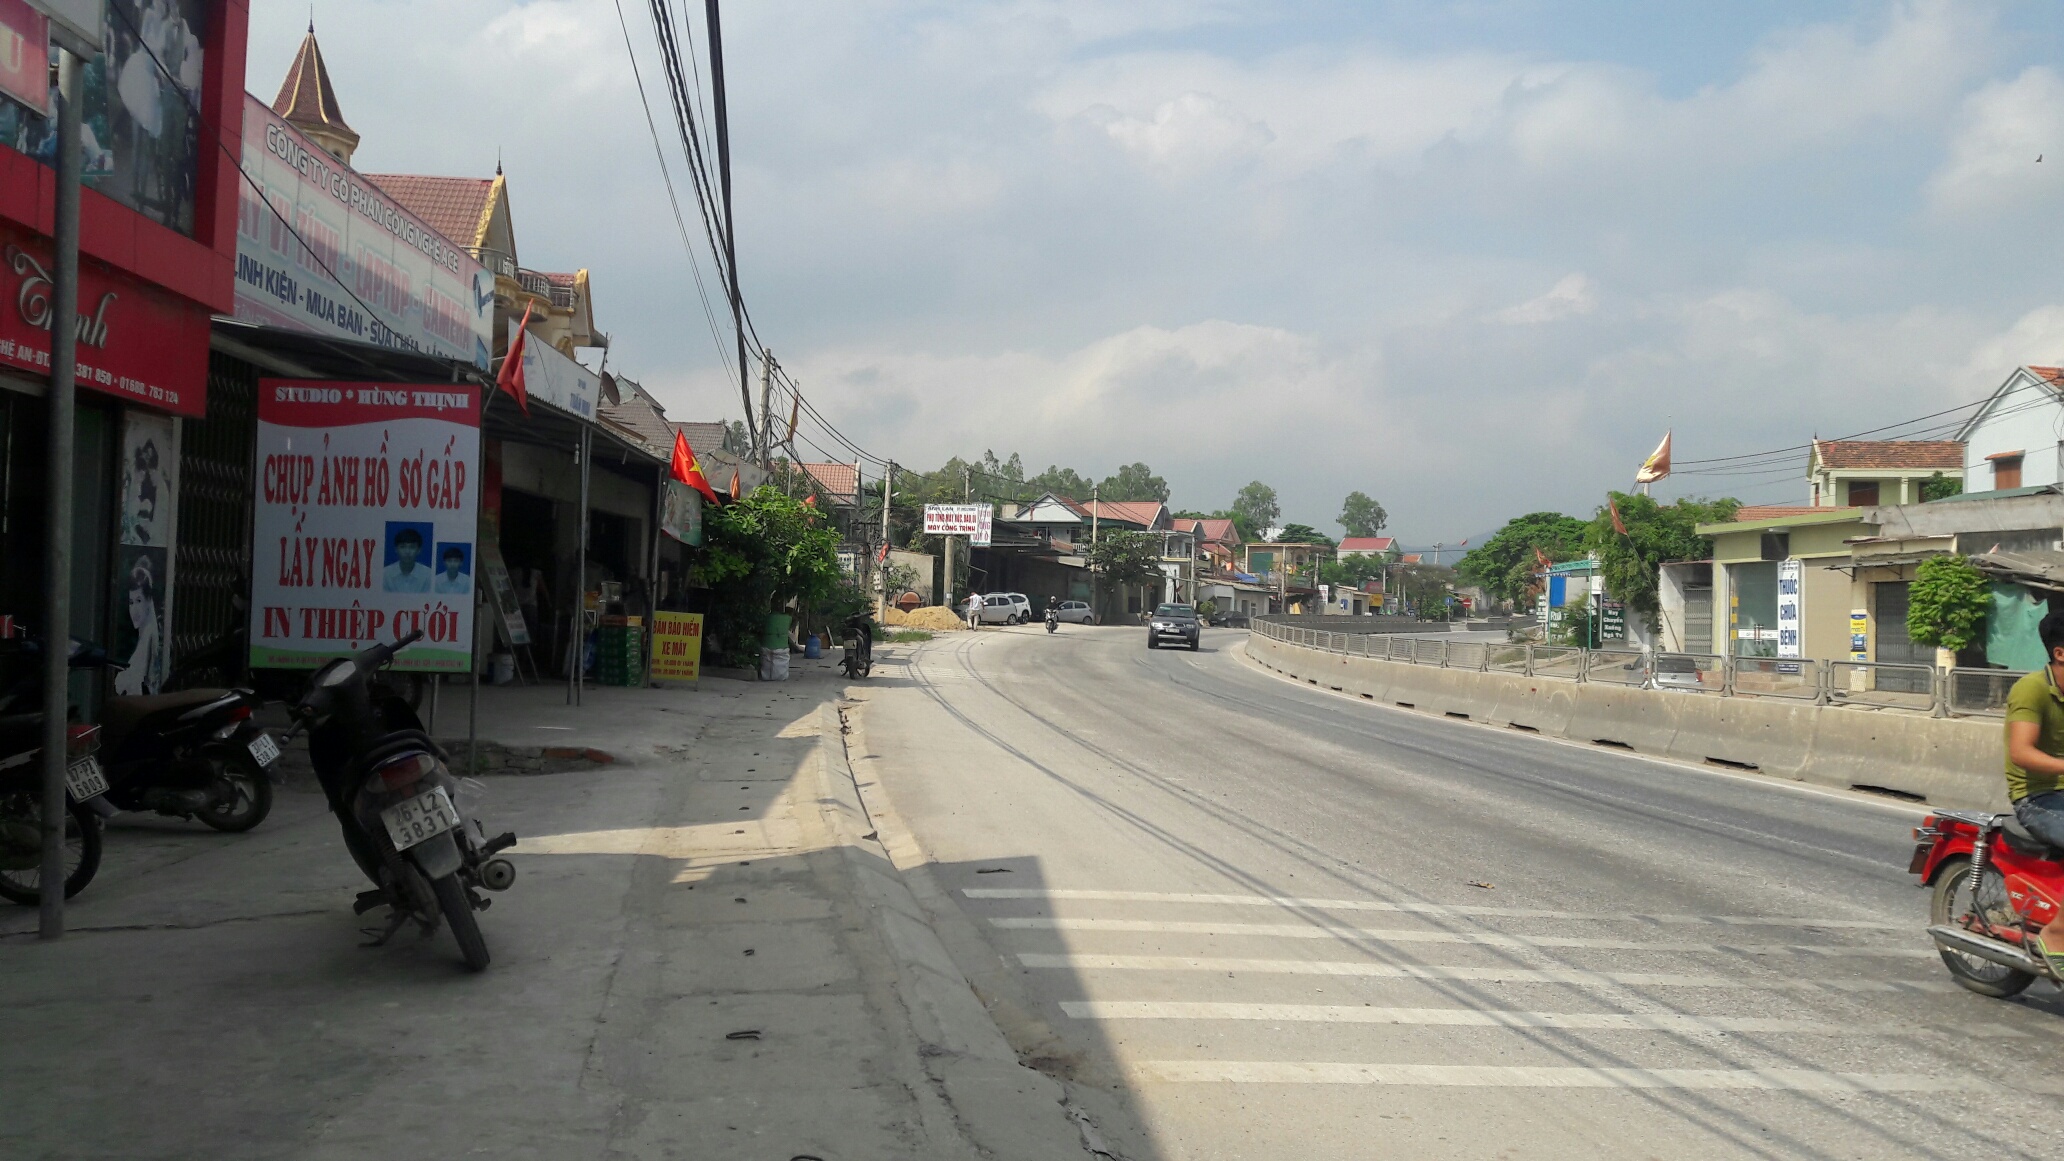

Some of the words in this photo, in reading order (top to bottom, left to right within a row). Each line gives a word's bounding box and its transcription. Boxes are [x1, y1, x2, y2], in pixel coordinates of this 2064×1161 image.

[266, 123, 309, 177] CÔNG
[310, 155, 329, 190] TY
[385, 207, 415, 247] CÔNG
[415, 227, 441, 265] NGHỆ
[441, 246, 459, 275] ACE
[265, 267, 297, 305] KIỆN
[306, 288, 335, 324] MUA
[337, 303, 363, 336] BÁN
[355, 243, 410, 319] LAPTOP
[423, 284, 471, 353] CAMERA
[165, 390, 179, 404] 124
[275, 386, 342, 404] STUDIO
[357, 386, 408, 406] HÙNG
[412, 391, 469, 411] THỊNH
[264, 453, 314, 516] CHỤP
[317, 432, 360, 506] ẢNH
[363, 429, 389, 508] HỒ
[399, 448, 424, 508] SƠ
[427, 434, 466, 509] GẤP
[942, 523, 957, 531] CÔNG
[960, 524, 976, 532] TRÌNH
[279, 511, 318, 587] LẤY
[321, 537, 376, 589] NGAY
[1779, 573, 1798, 595] THUỐC
[1780, 600, 1797, 620] CHỮA
[262, 606, 292, 638] IN
[300, 599, 385, 650] THIỆP
[392, 601, 459, 642] CƯỚI
[653, 617, 667, 634] BÁN
[662, 641, 671, 655] XE
[672, 639, 687, 656] MÁY
[1780, 626, 1797, 649] BỆNH
[399, 810, 450, 843] 3831
